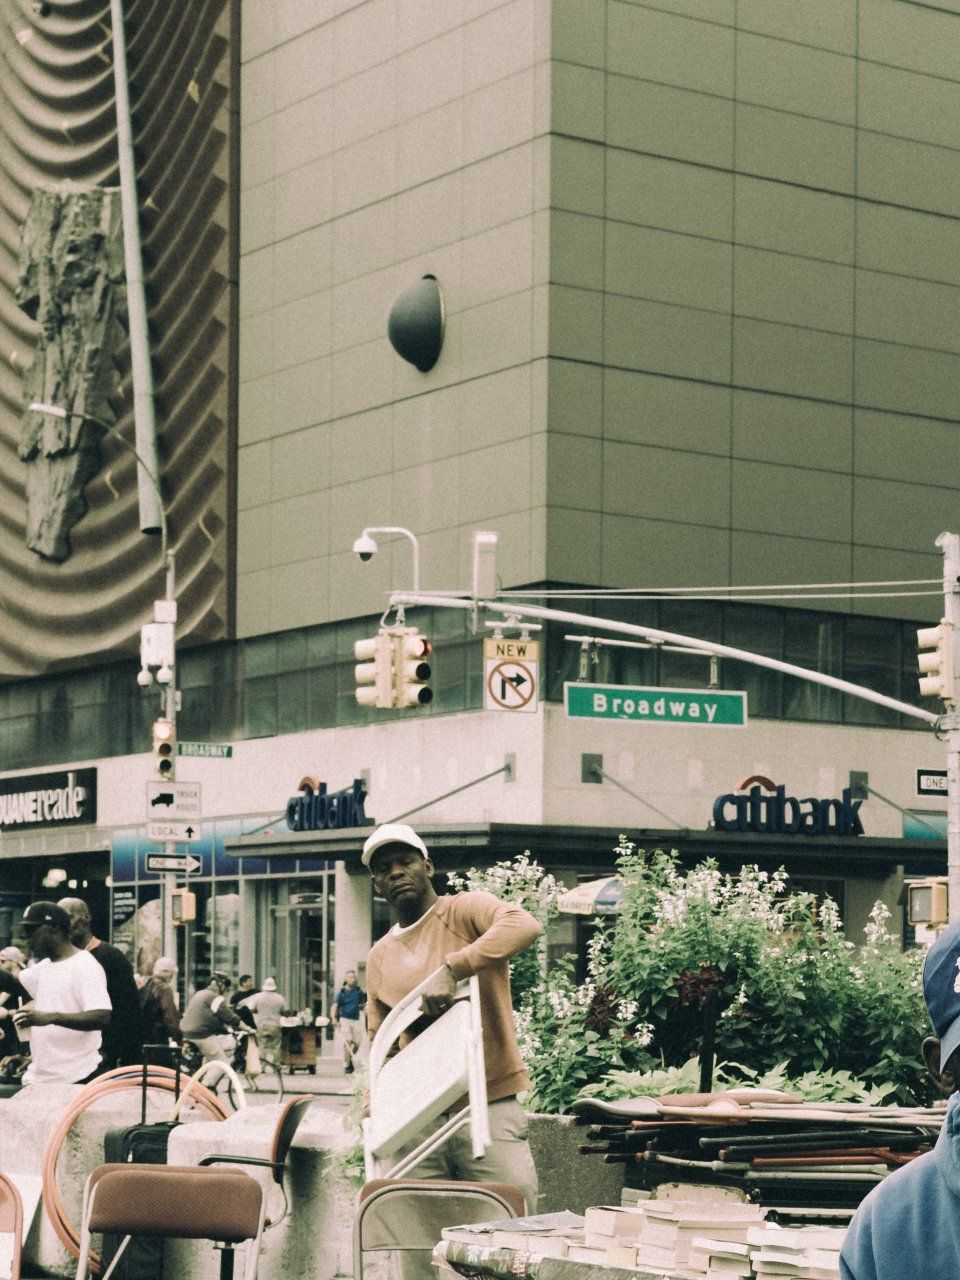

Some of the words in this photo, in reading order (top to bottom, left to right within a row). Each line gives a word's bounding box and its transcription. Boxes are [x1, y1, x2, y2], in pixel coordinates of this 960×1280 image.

[496, 644, 527, 656] NEW
[593, 693, 717, 722] Broadway
[925, 777, 944, 788] ONE
[713, 785, 865, 836] citibank
[152, 826, 178, 836] LOCAL
